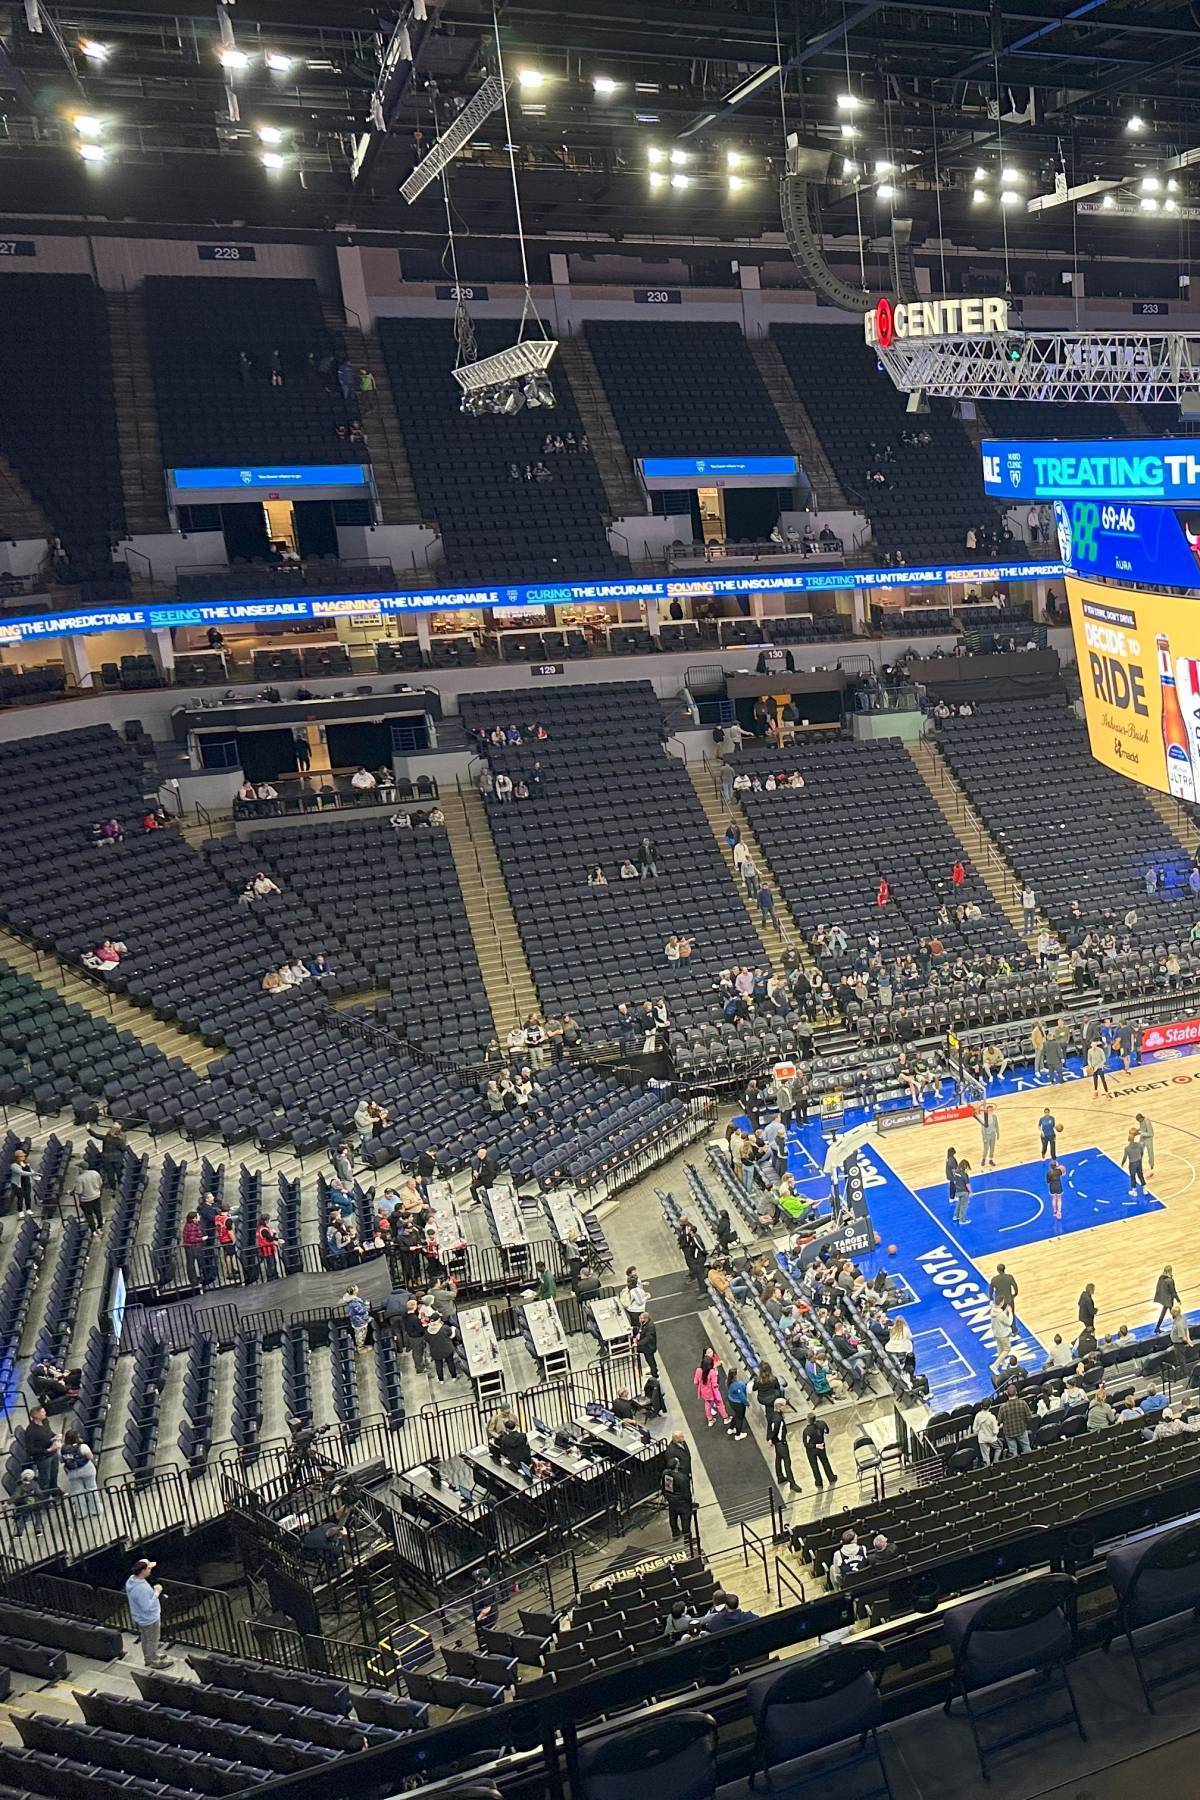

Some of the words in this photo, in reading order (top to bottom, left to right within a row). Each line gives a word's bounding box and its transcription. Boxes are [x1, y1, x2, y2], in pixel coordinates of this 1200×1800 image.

[214, 247, 240, 260] 228
[647, 291, 668, 303] 230
[894, 297, 1009, 338] CENTER
[1142, 304, 1159, 314] 233
[1033, 455, 1164, 486] TREATING
[1102, 505, 1136, 532] 69:46
[20, 621, 46, 635] THE
[44, 611, 145, 632] UNPREDICTABLE
[149, 608, 200, 623] SEEING
[200, 607, 231, 619] THE
[230, 602, 307, 617] UNSEEABLE
[312, 598, 381, 613] IMAGINING
[381, 597, 407, 609] THE
[407, 591, 499, 607] UNIMAGINABLE
[526, 588, 571, 600] CURING
[571, 587, 596, 598] THE
[596, 583, 663, 596] UNCURABLE
[667, 581, 713, 593] SOLVING
[713, 580, 738, 591] THE
[736, 577, 803, 590] UNSOLVABLE
[805, 574, 855, 586] TREATING
[854, 573, 877, 584] THE
[876, 571, 942, 583] UNTREATABLE
[945, 568, 1000, 580] PREDICTING
[999, 567, 1018, 577] THE
[1084, 622, 1127, 657] DECIDE
[1127, 638, 1141, 657] TO
[768, 649, 784, 660] 130
[539, 664, 556, 676] 129
[1088, 650, 1149, 718] RIDE
[1120, 750, 1139, 764] madd
[1102, 1079, 1169, 1100] TARGET
[833, 1234, 868, 1249] TARGET
[838, 1241, 869, 1254] ENTER
[616, 1551, 687, 1579] HENNEPIN
